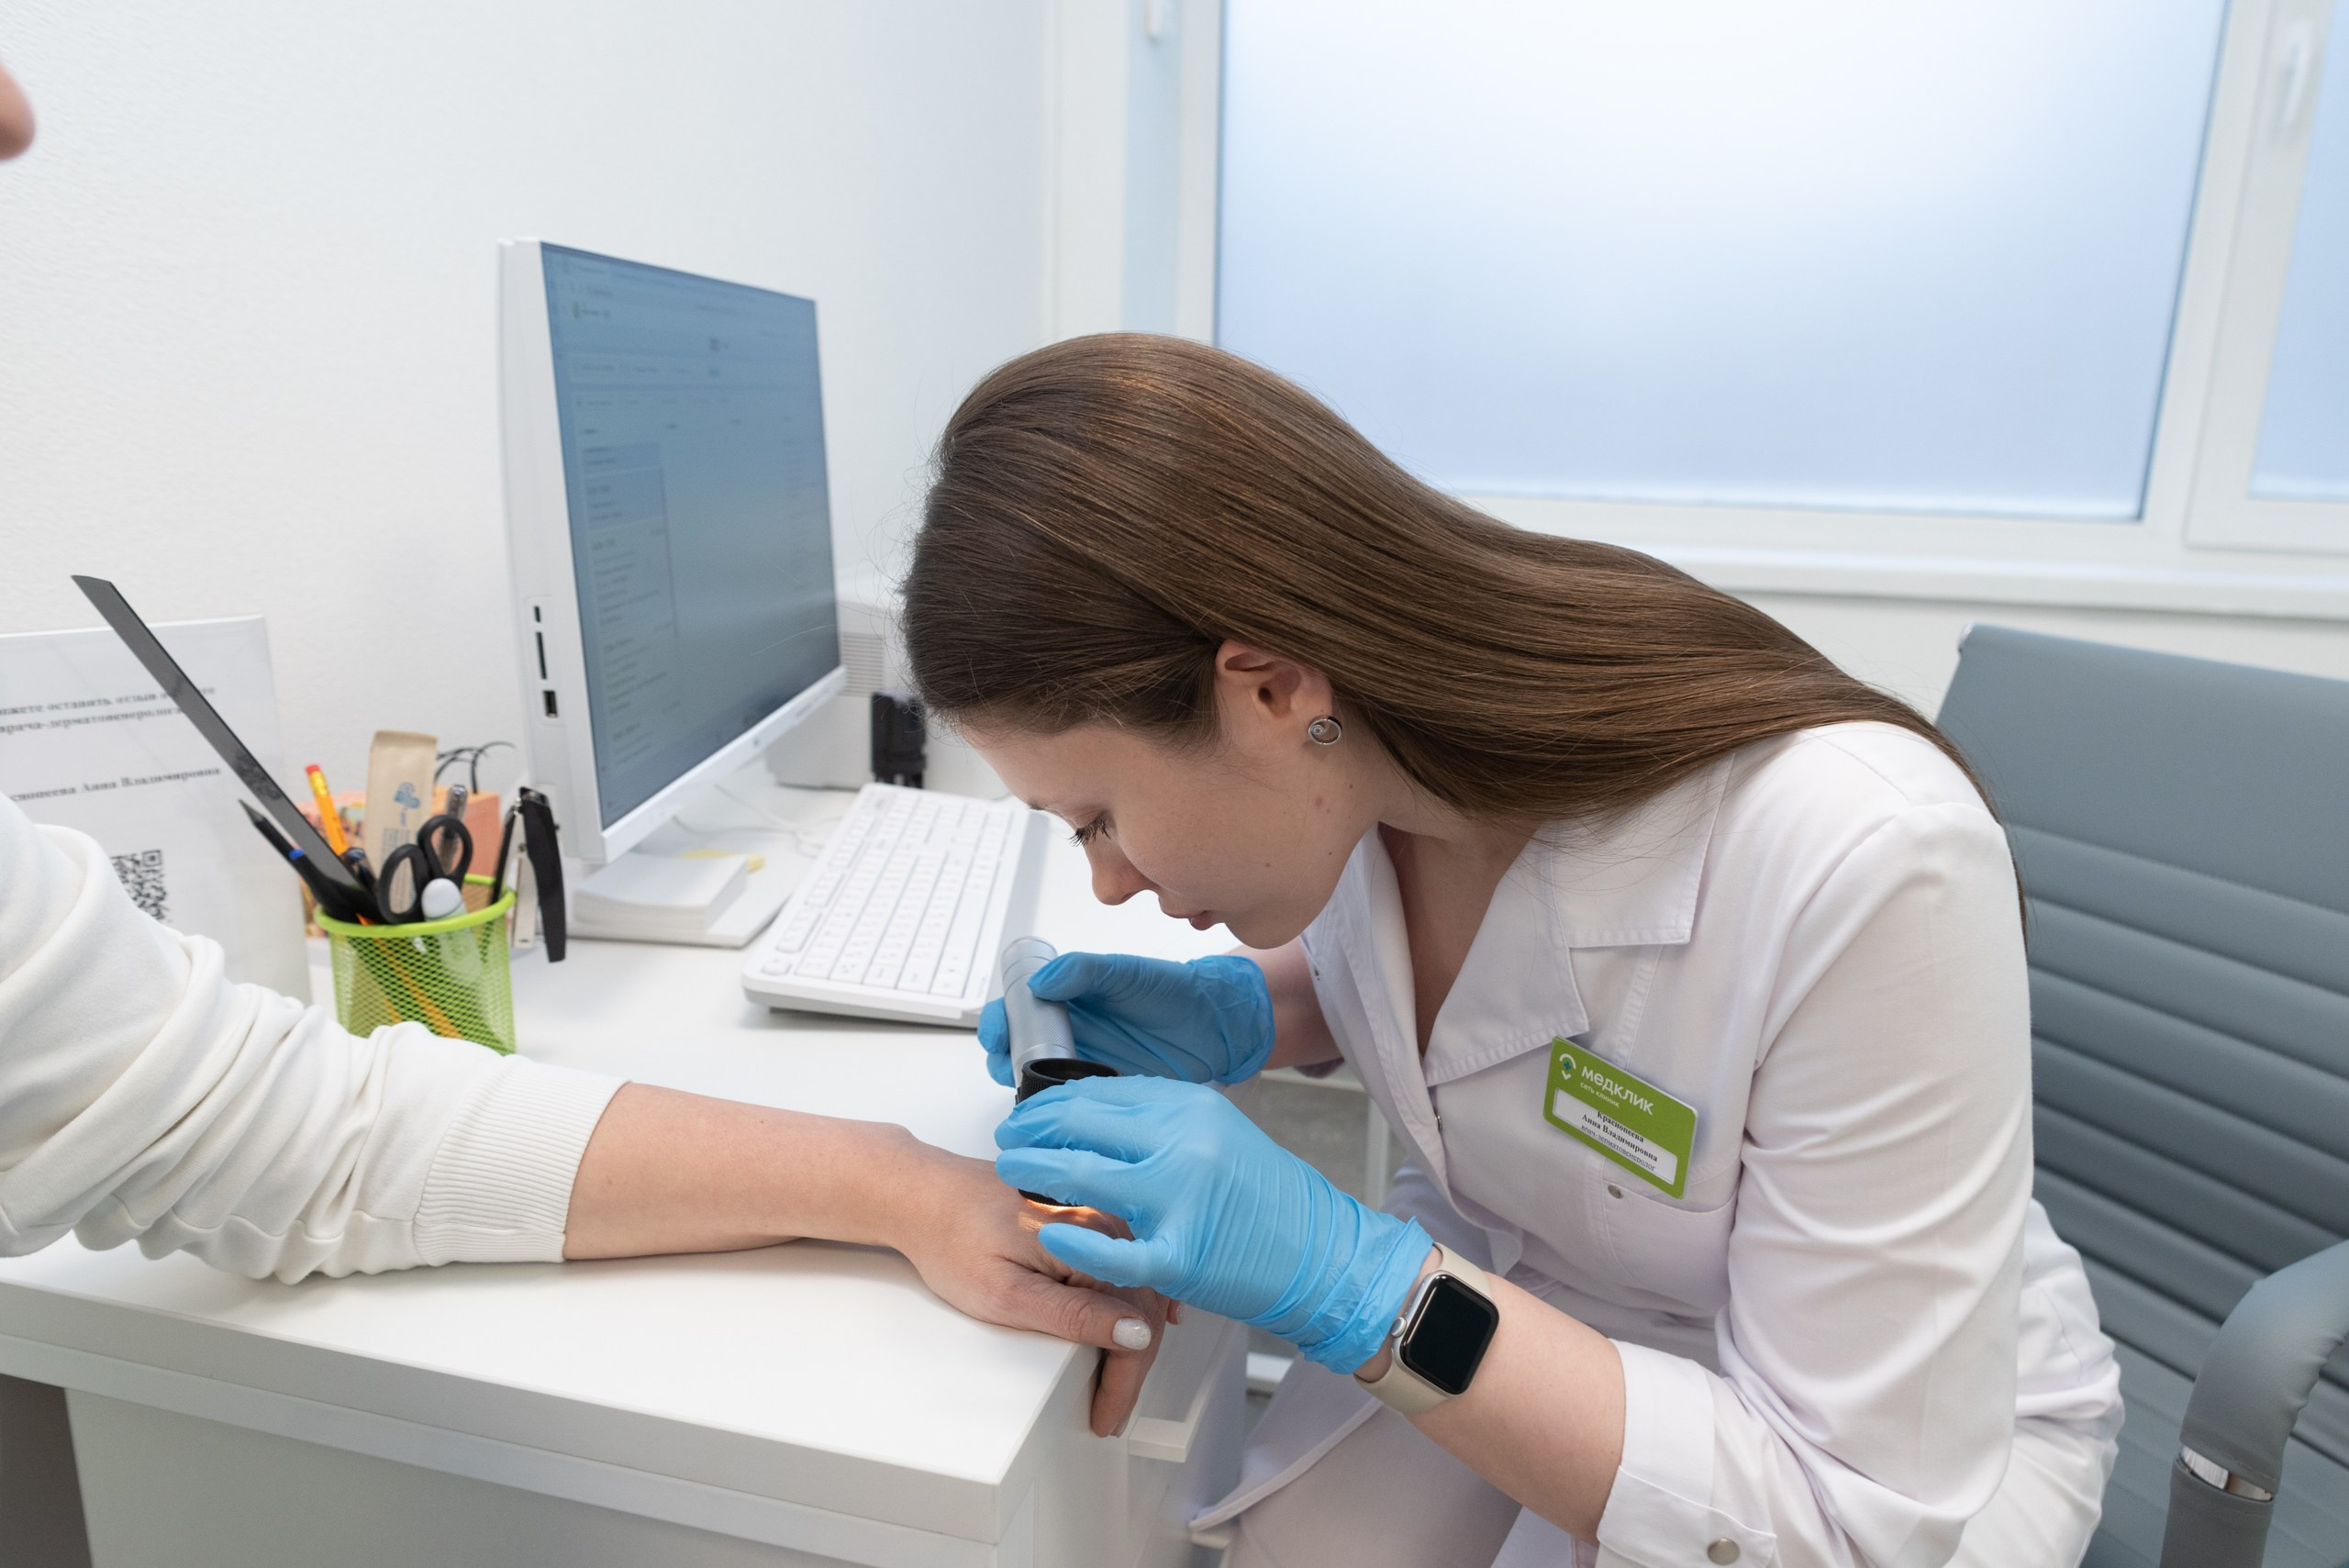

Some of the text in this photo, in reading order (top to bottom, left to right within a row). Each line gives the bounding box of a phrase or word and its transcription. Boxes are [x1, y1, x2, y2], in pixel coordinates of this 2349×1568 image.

[1596, 1091, 1620, 1107] клиник
[1582, 1114, 1658, 1162] Анна Владимировна
